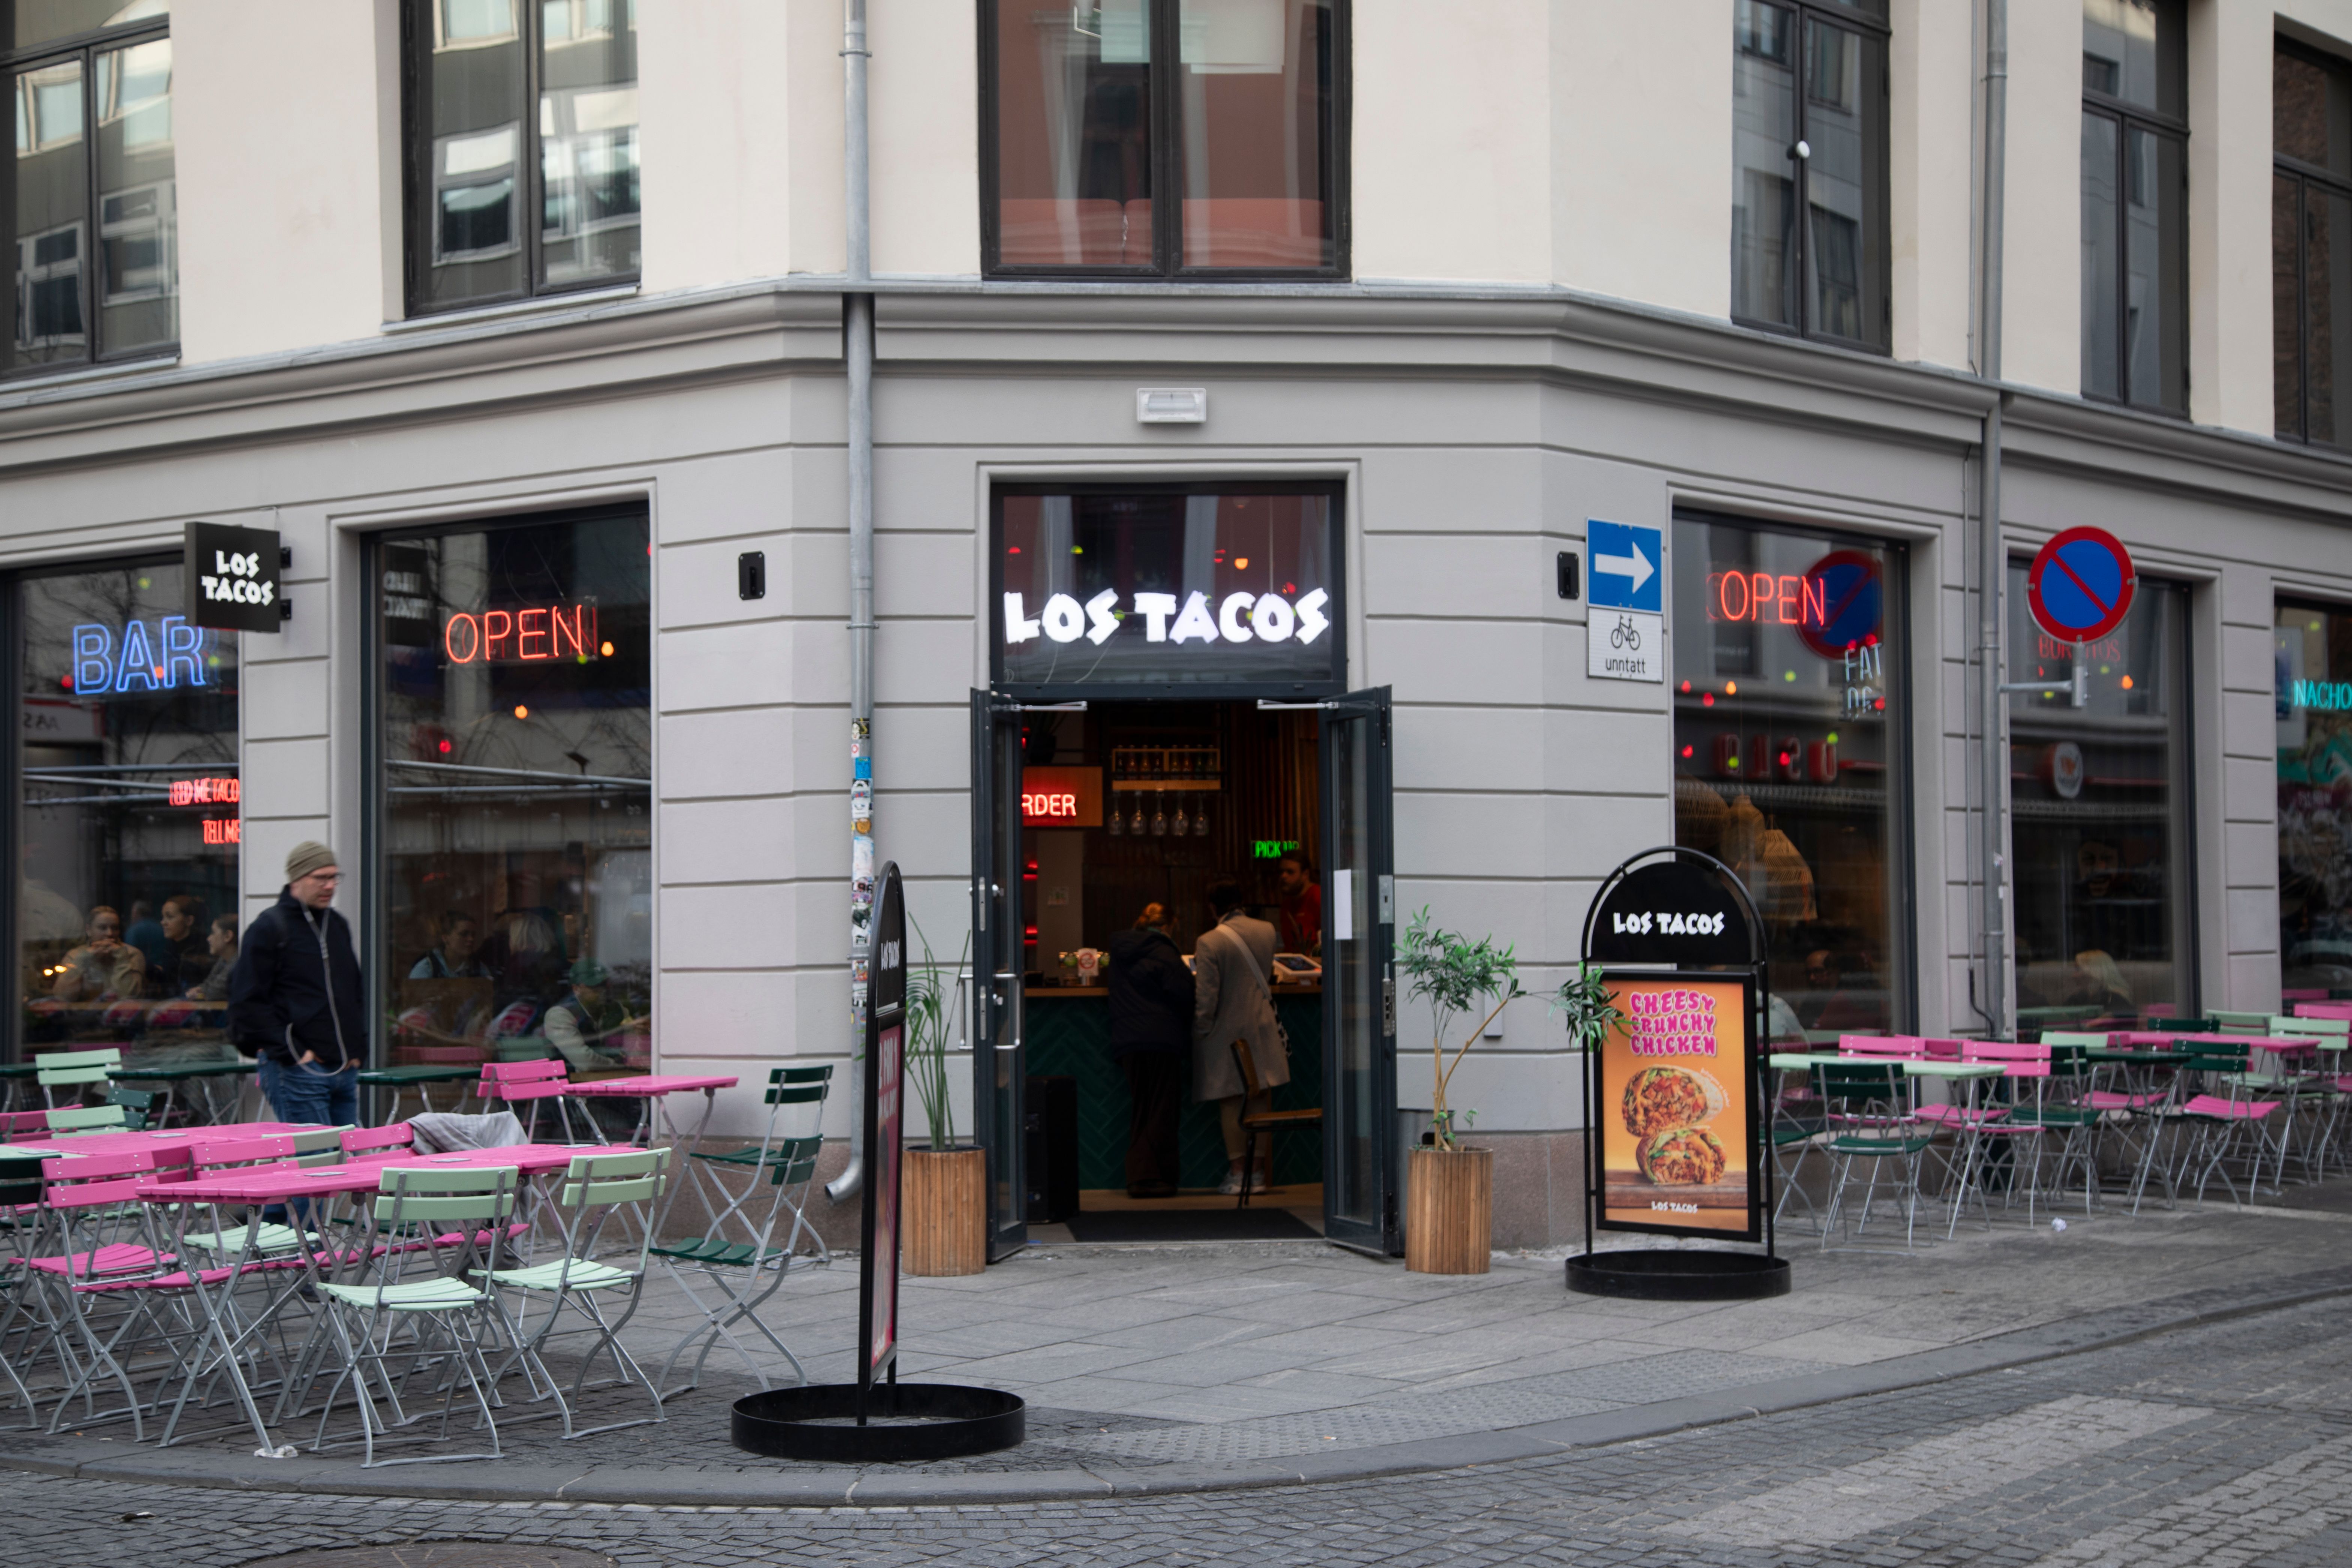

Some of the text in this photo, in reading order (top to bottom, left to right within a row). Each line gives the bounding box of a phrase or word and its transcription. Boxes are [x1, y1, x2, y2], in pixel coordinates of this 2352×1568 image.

[216, 550, 260, 578] LOS
[201, 576, 274, 606] TACOS
[1721, 571, 1825, 626] OPEN
[1004, 588, 1329, 645] LOS TACOS
[446, 605, 584, 663] OPEN
[73, 616, 206, 695] BAR
[2038, 634, 2120, 662] BURITOS
[1605, 657, 1646, 674] unntatt
[2293, 678, 2352, 710] NACHO
[203, 819, 241, 844] TELL ME
[1255, 840, 1281, 858] PICK
[1613, 911, 1724, 936] LOS TACOS
[1630, 989, 1716, 1015] CHEESY
[1630, 1012, 1716, 1035] CRUNCHY
[1630, 1034, 1717, 1056] CHICKEN
[1651, 1201, 1698, 1213] LOS TACOS
